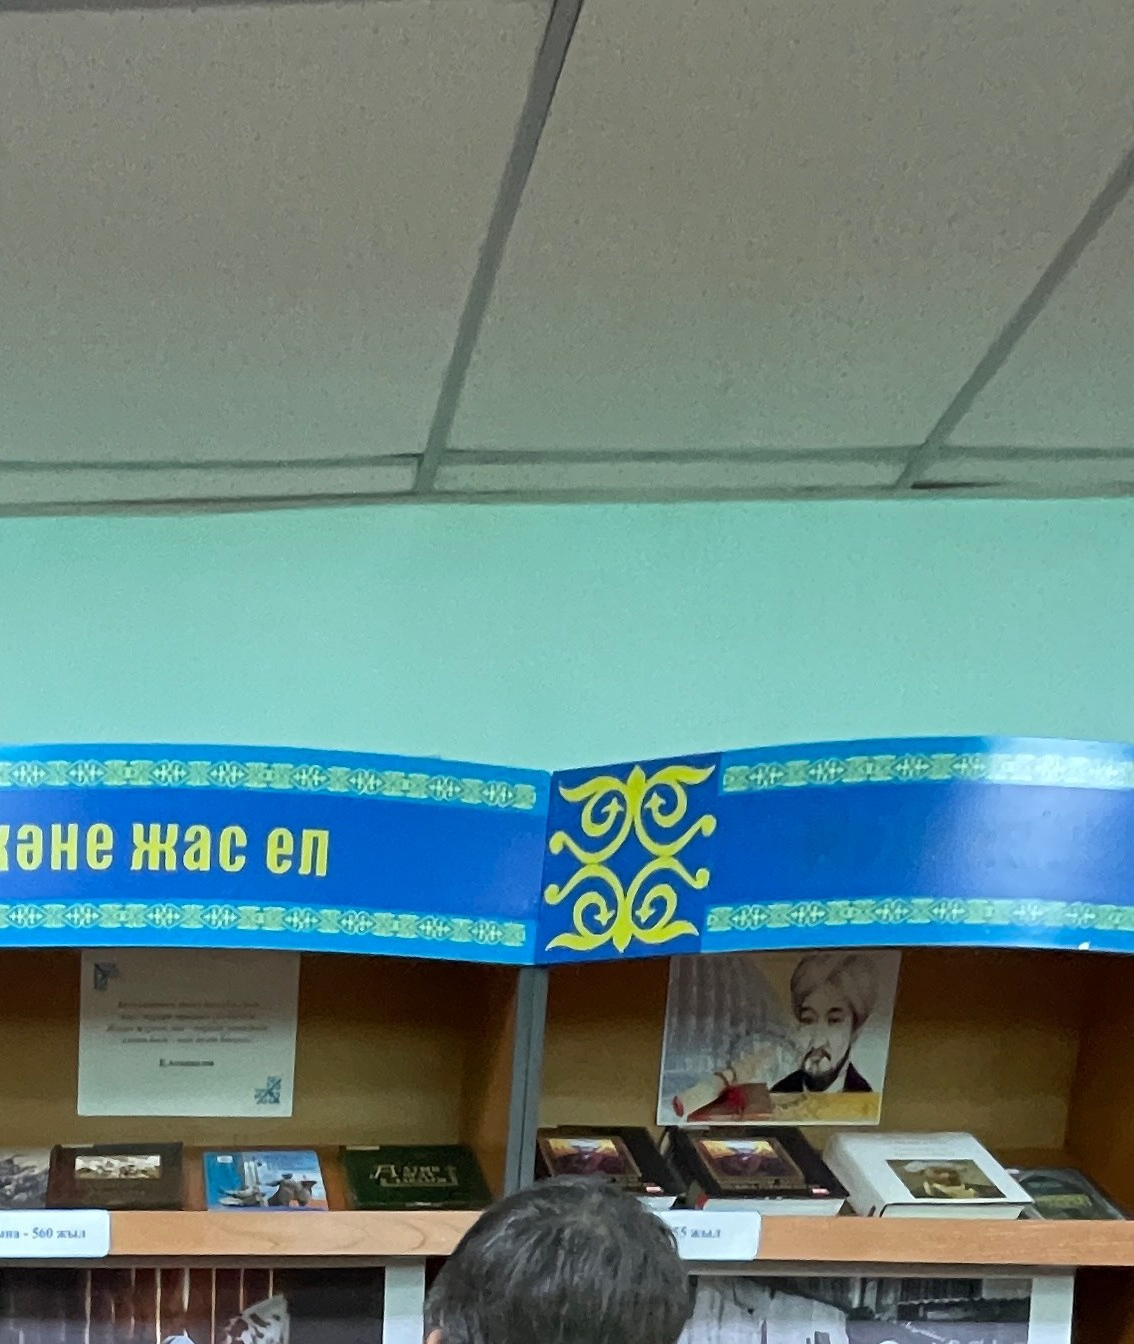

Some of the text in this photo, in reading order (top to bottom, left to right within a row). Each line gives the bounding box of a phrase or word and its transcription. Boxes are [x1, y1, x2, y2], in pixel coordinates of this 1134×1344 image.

[129, 823, 247, 873] жас
[265, 828, 331, 877] ел
[32, 1227, 53, 1239] 560
[56, 1229, 86, 1239] жыл
